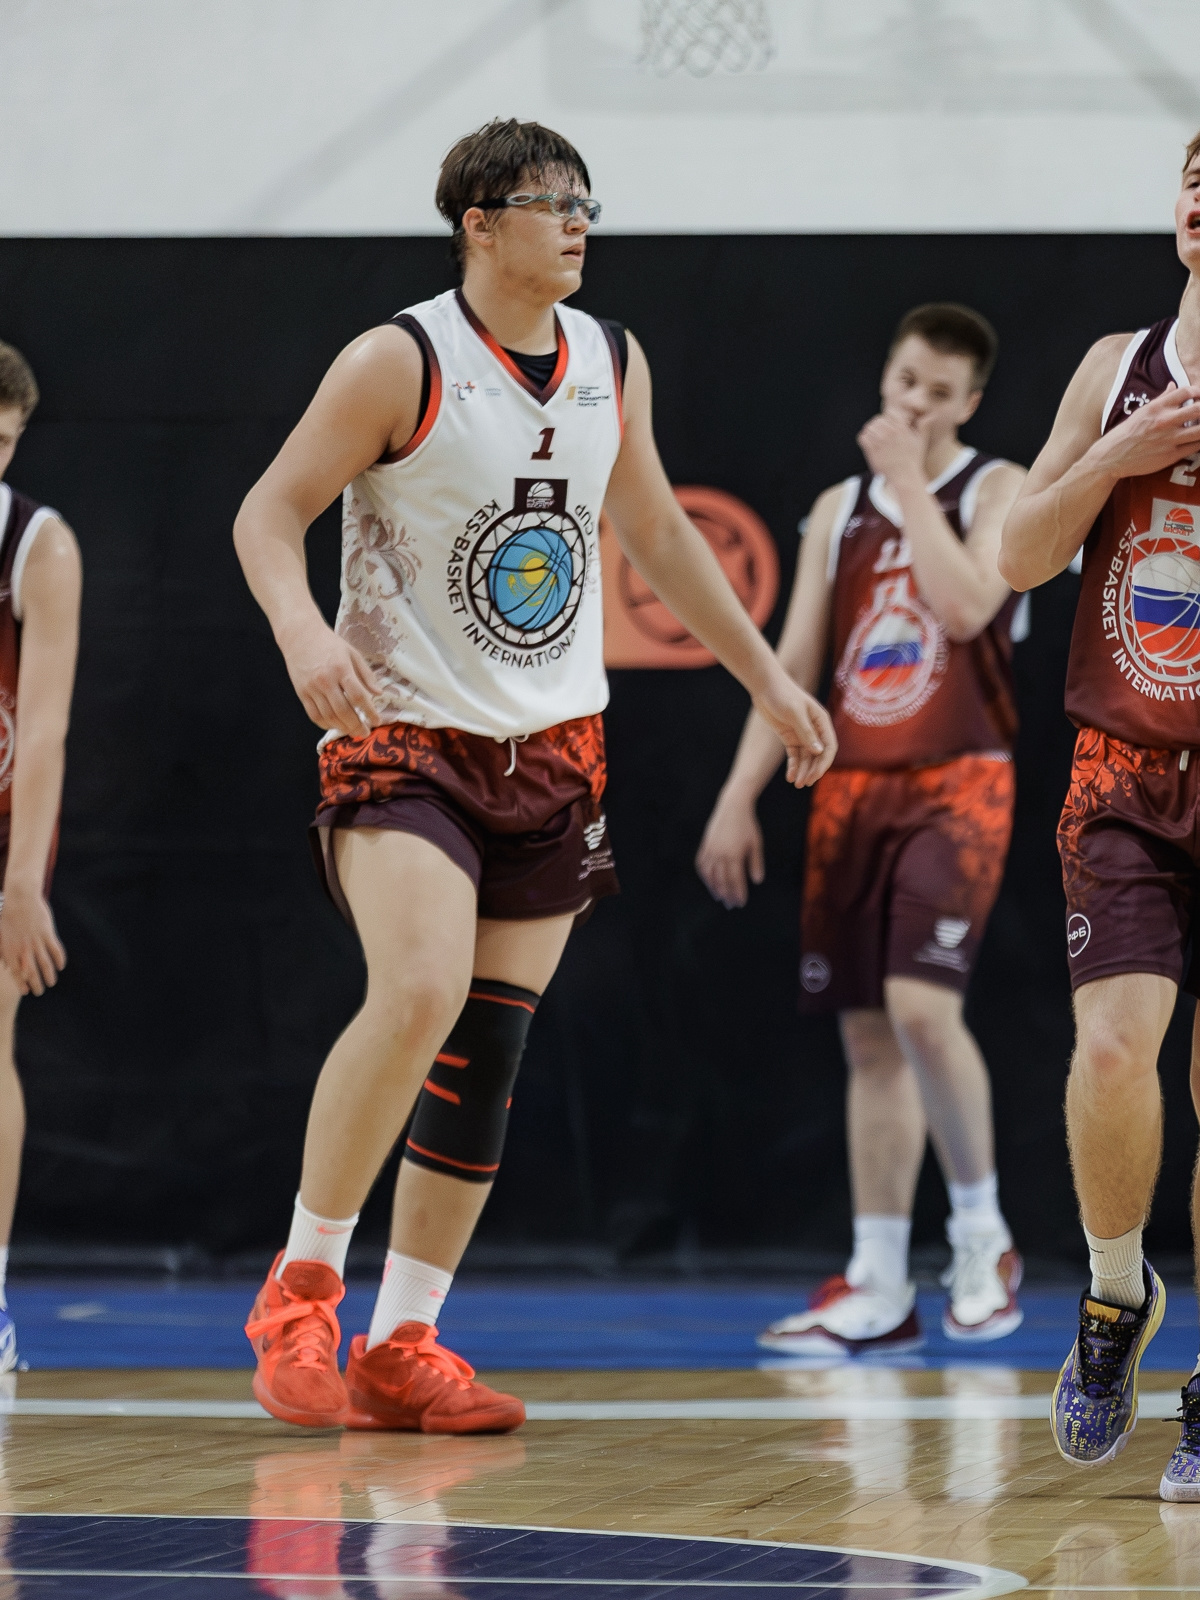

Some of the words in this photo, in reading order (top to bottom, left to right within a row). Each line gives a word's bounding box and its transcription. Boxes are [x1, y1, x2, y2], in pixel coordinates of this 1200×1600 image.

[530, 427, 556, 461] 1
[446, 498, 502, 615] KES-BASKET
[462, 621, 579, 670] INTERNATION
